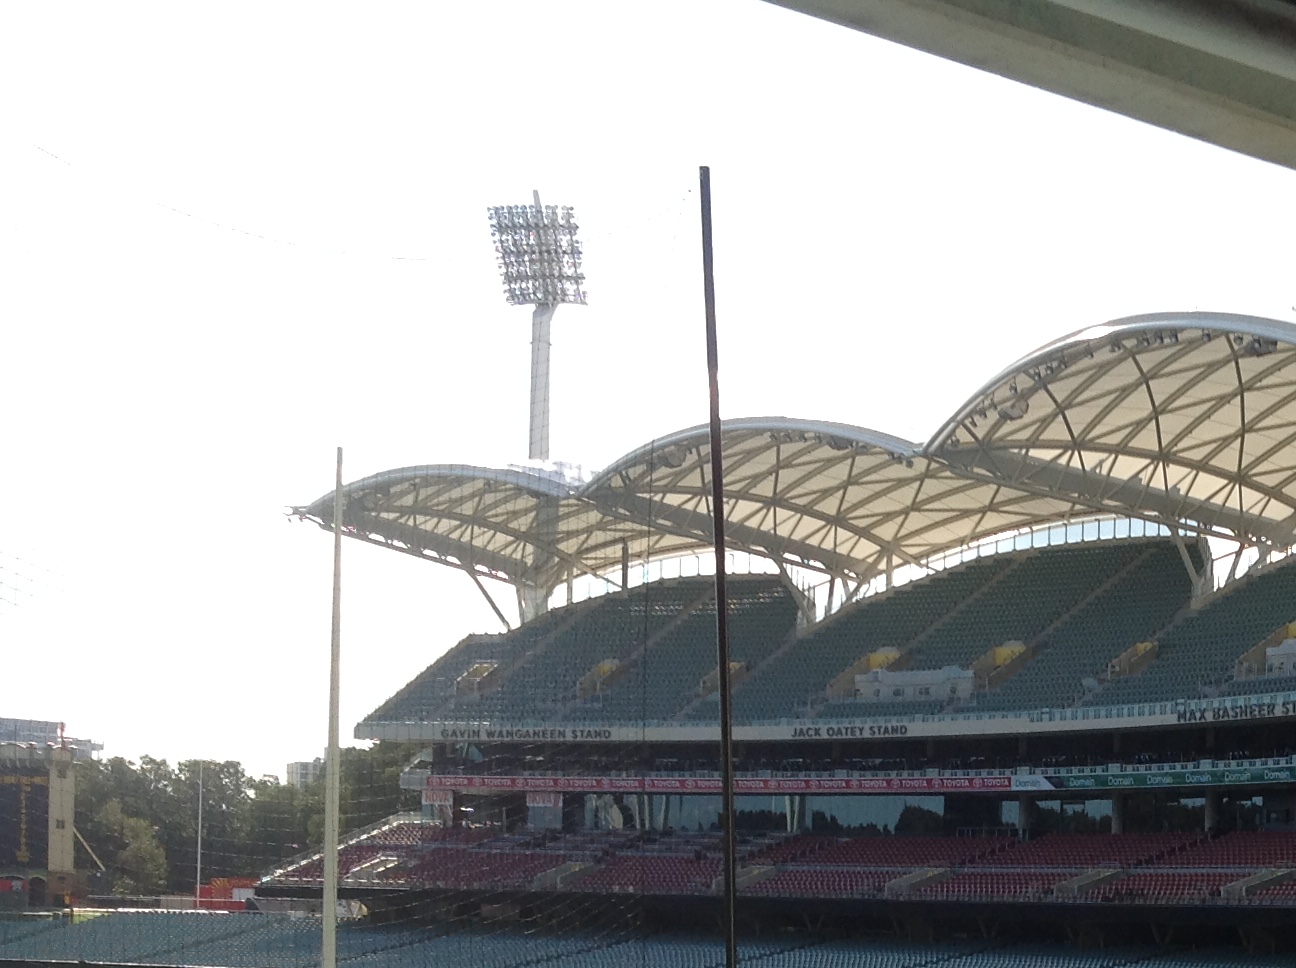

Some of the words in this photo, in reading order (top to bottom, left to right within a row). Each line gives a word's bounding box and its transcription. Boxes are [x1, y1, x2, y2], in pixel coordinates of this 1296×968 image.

[1176, 707, 1207, 723] MAX
[1212, 703, 1276, 721] BASHEER
[440, 729, 480, 739] GAVIN
[486, 729, 567, 739] WANGANEEN
[571, 729, 612, 739] STAND
[791, 726, 822, 738] JACK
[826, 725, 865, 738] OATEY
[868, 724, 908, 736] STAND
[1147, 775, 1173, 784] Domain
[1185, 773, 1212, 783] Domain
[1224, 772, 1250, 782] Domain
[1264, 770, 1290, 780] Domain
[484, 778, 512, 786] TOYOTA
[527, 779, 554, 787] TOYOTA
[569, 779, 597, 787] TOYOTA
[612, 780, 639, 788] TOYOTA
[654, 780, 680, 788] TOYOTA
[697, 780, 723, 789] TOYOTA
[737, 780, 765, 788] TOYOTA
[780, 780, 806, 788] TOYOTA
[820, 780, 846, 788] TOYOTA
[861, 780, 887, 788] TOYOTA
[902, 779, 927, 788] TOYOTA
[943, 779, 969, 787] TOYOTA
[984, 778, 1009, 787] TOYOTA
[1069, 777, 1095, 787] Domain
[1108, 776, 1134, 786] Domain
